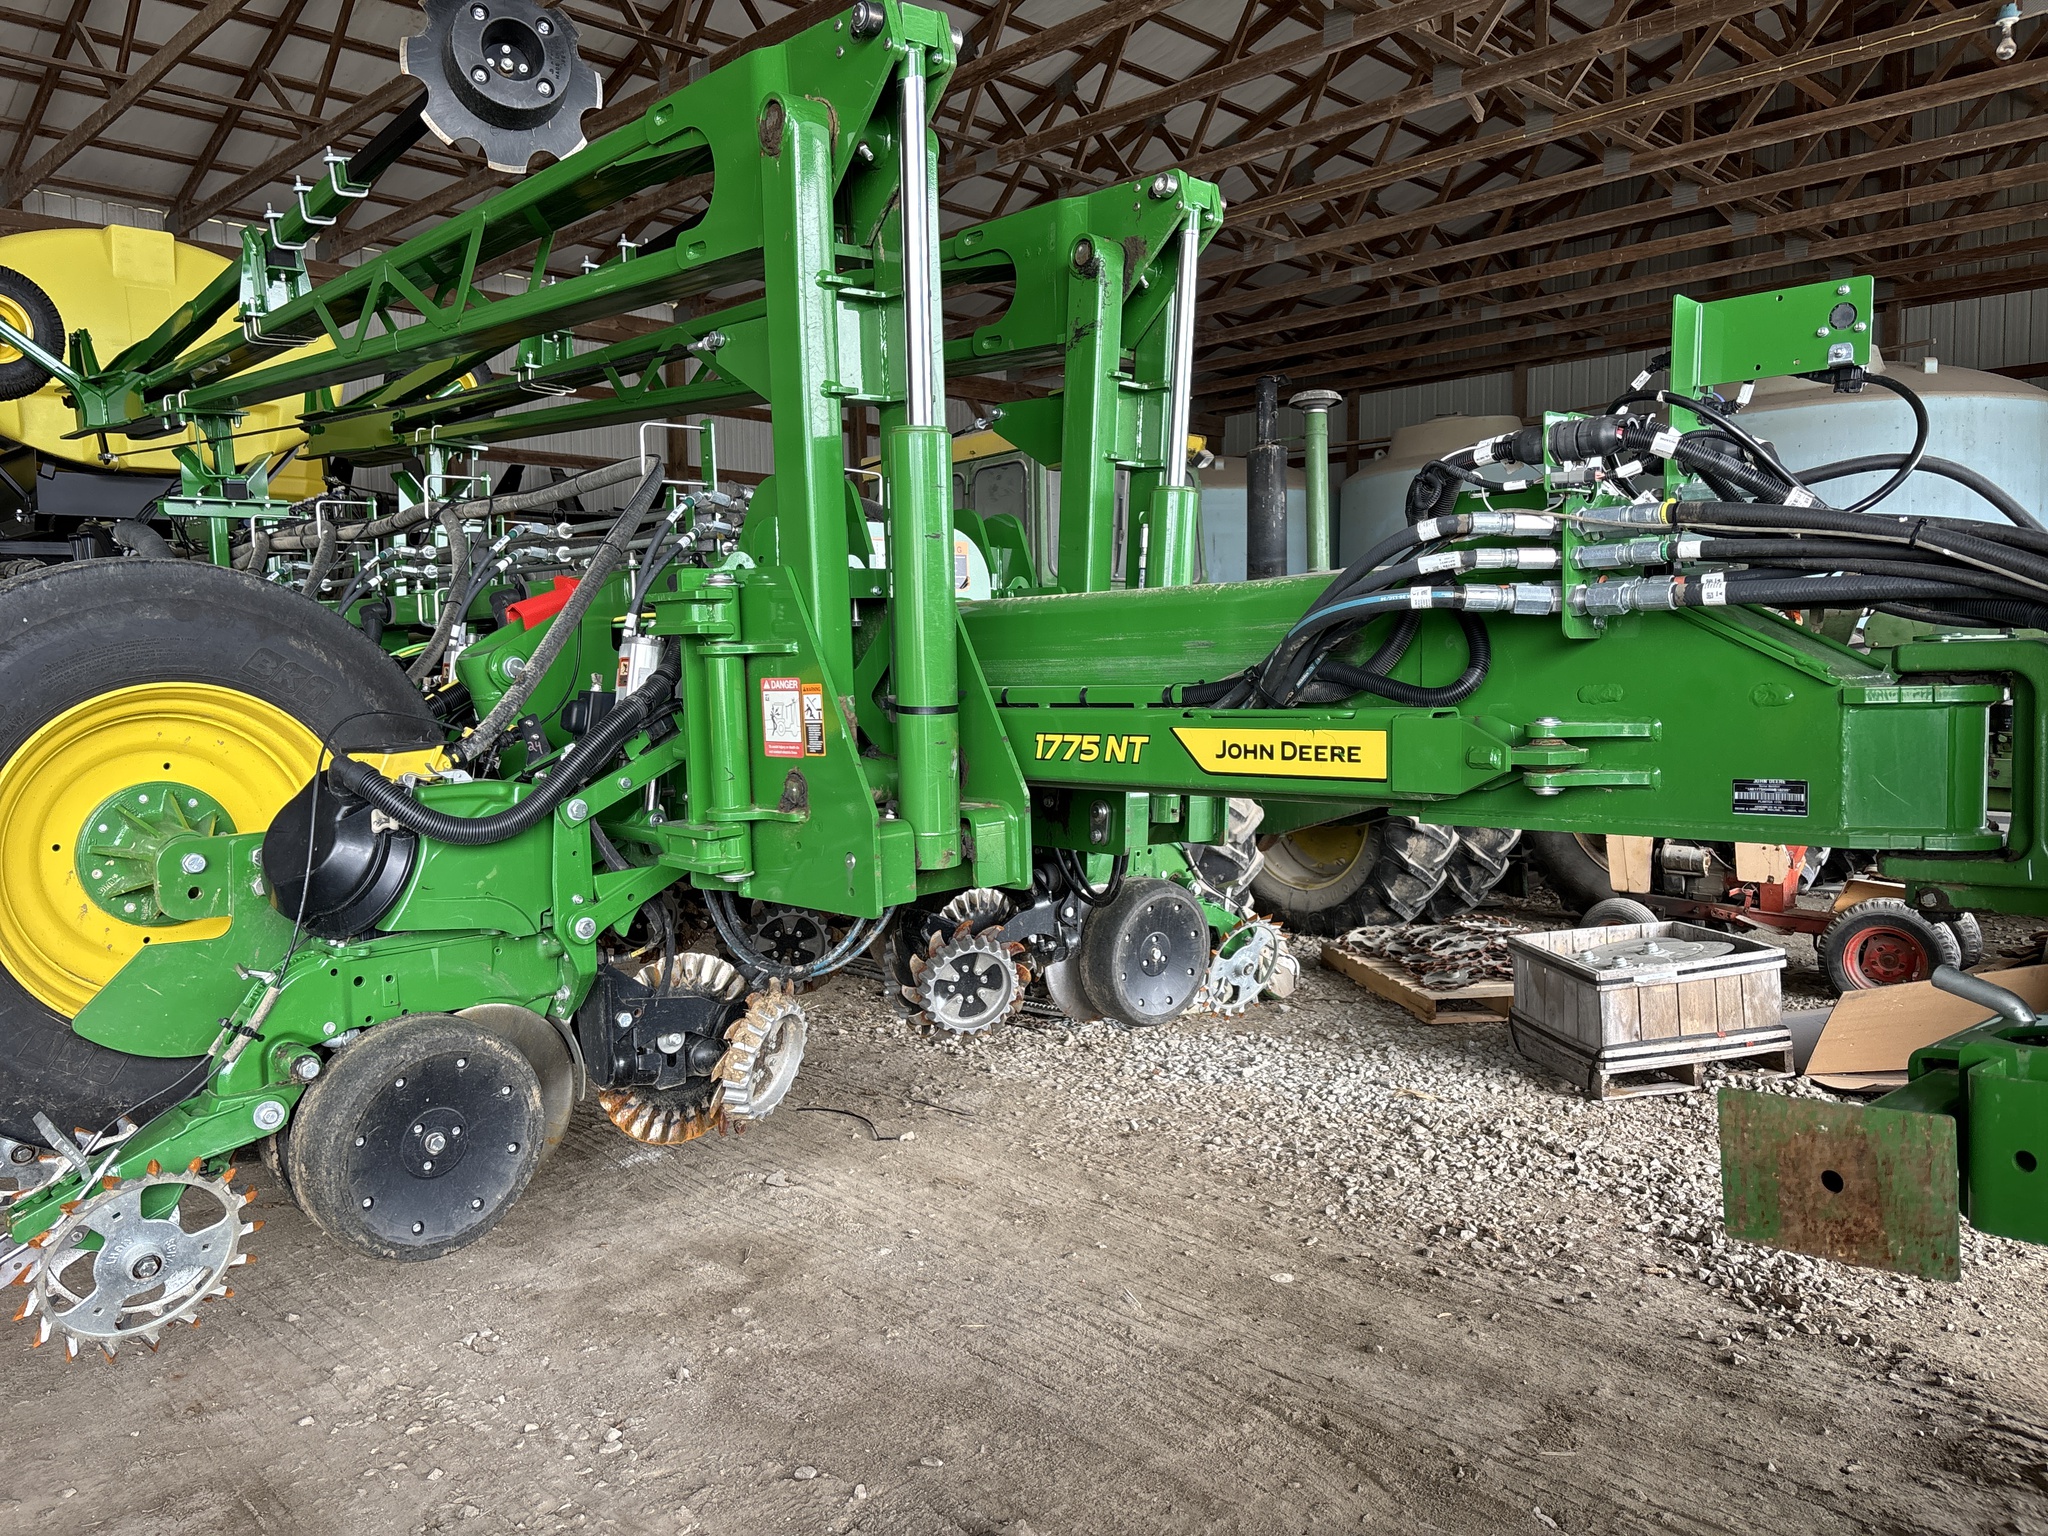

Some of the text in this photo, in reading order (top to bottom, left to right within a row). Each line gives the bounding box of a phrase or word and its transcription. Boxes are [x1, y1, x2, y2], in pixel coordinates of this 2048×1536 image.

[244, 651, 335, 705] BKT
[770, 680, 798, 689] DANGER
[527, 741, 544, 754] 24
[1035, 732, 1150, 765] 1775 NT
[1215, 740, 1362, 763] JOHN DEERE
